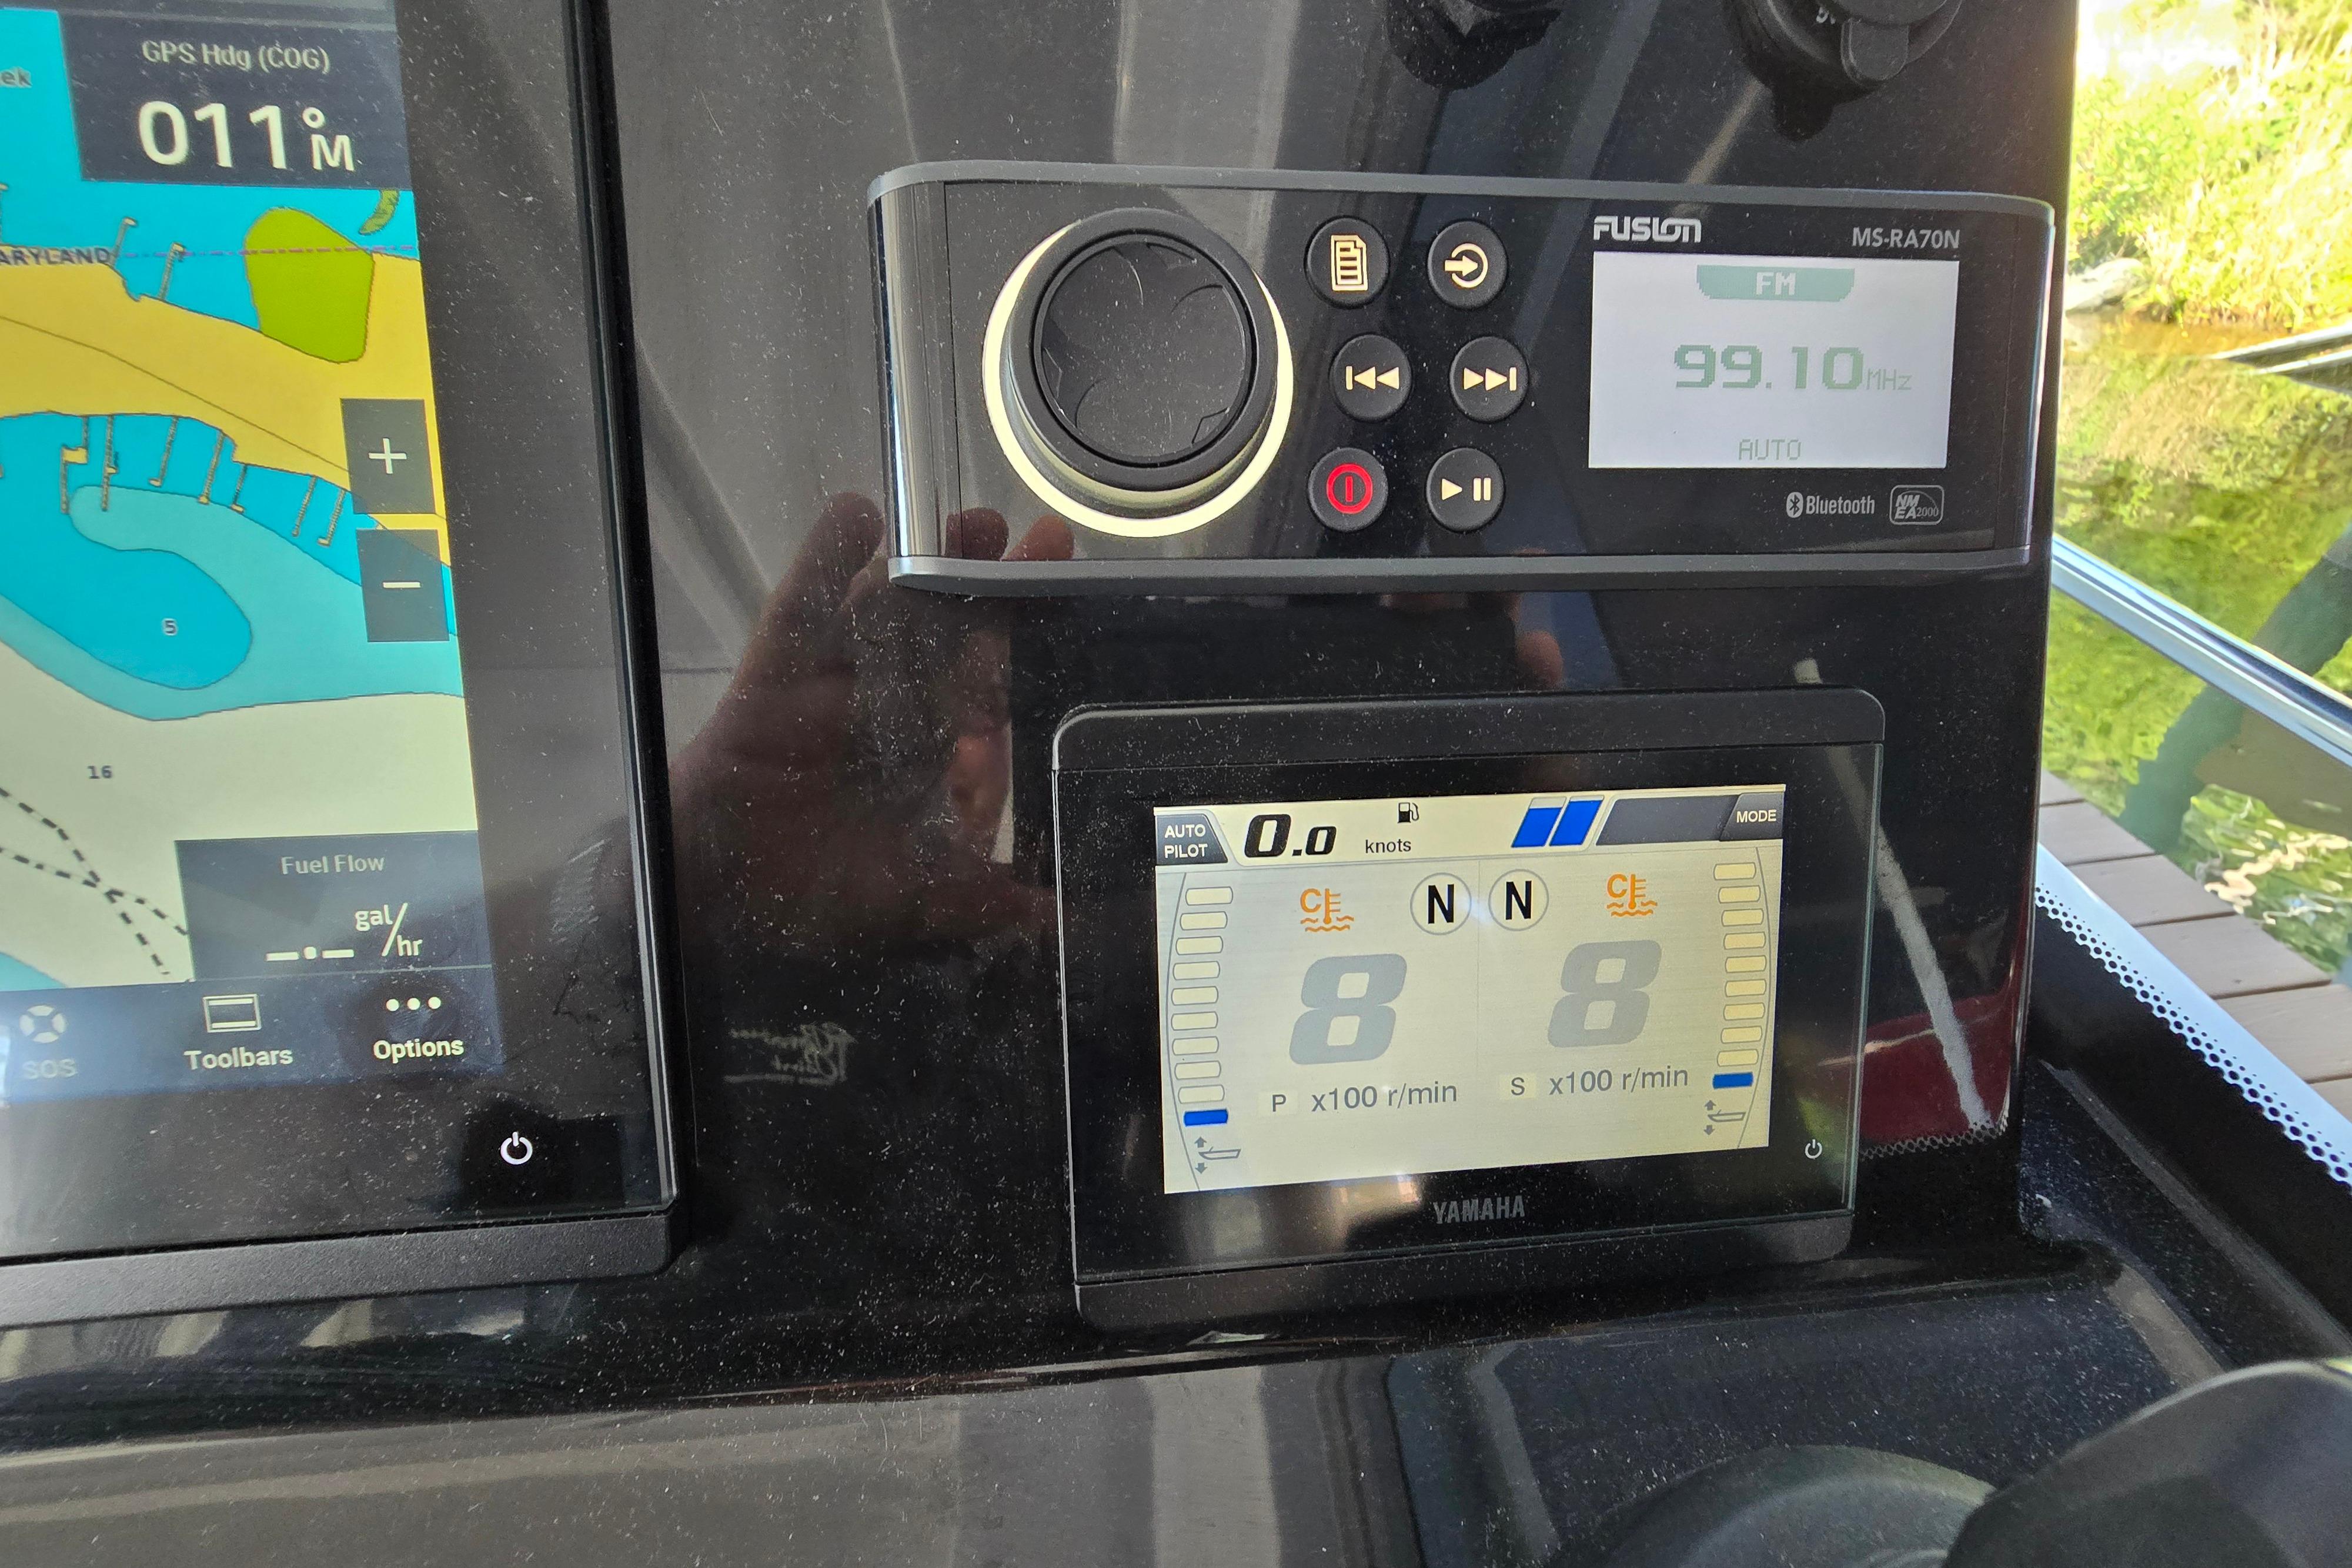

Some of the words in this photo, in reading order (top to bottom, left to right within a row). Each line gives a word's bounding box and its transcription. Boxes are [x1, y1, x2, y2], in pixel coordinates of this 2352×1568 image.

[142, 40, 198, 65] GPS
[201, 43, 252, 72] Hdg
[259, 45, 330, 75] (COG)
[1852, 227, 1960, 249] MS-RA70N
[1755, 272, 1796, 296] FM
[1673, 344, 1864, 390] 99.10
[1866, 370, 1913, 391] MHz
[1738, 439, 1802, 461] AUTO
[1806, 496, 1876, 515] Bluetooth
[163, 620, 177, 636] 5
[88, 765, 113, 780] 16
[1736, 809, 1777, 823] MODE
[1165, 824, 1205, 838] AUTO
[1244, 814, 1337, 858] 0.0
[1365, 839, 1412, 854] knots
[1164, 843, 1208, 858] PILOT
[281, 855, 329, 875] Fuel
[334, 854, 385, 873] Flow
[1427, 884, 1455, 924] N
[1505, 880, 1532, 920] N
[184, 1048, 294, 1071] Toolbars
[373, 1039, 465, 1064] Options
[22, 1059, 79, 1080] SOS
[1510, 1077, 1526, 1096] S
[1549, 1069, 1613, 1095] x100
[1622, 1065, 1689, 1094] r/min
[1271, 1094, 1287, 1112] P
[1311, 1085, 1378, 1112] x100
[1388, 1081, 1458, 1109] r/min
[1434, 1194, 1525, 1224] YAMAHA
